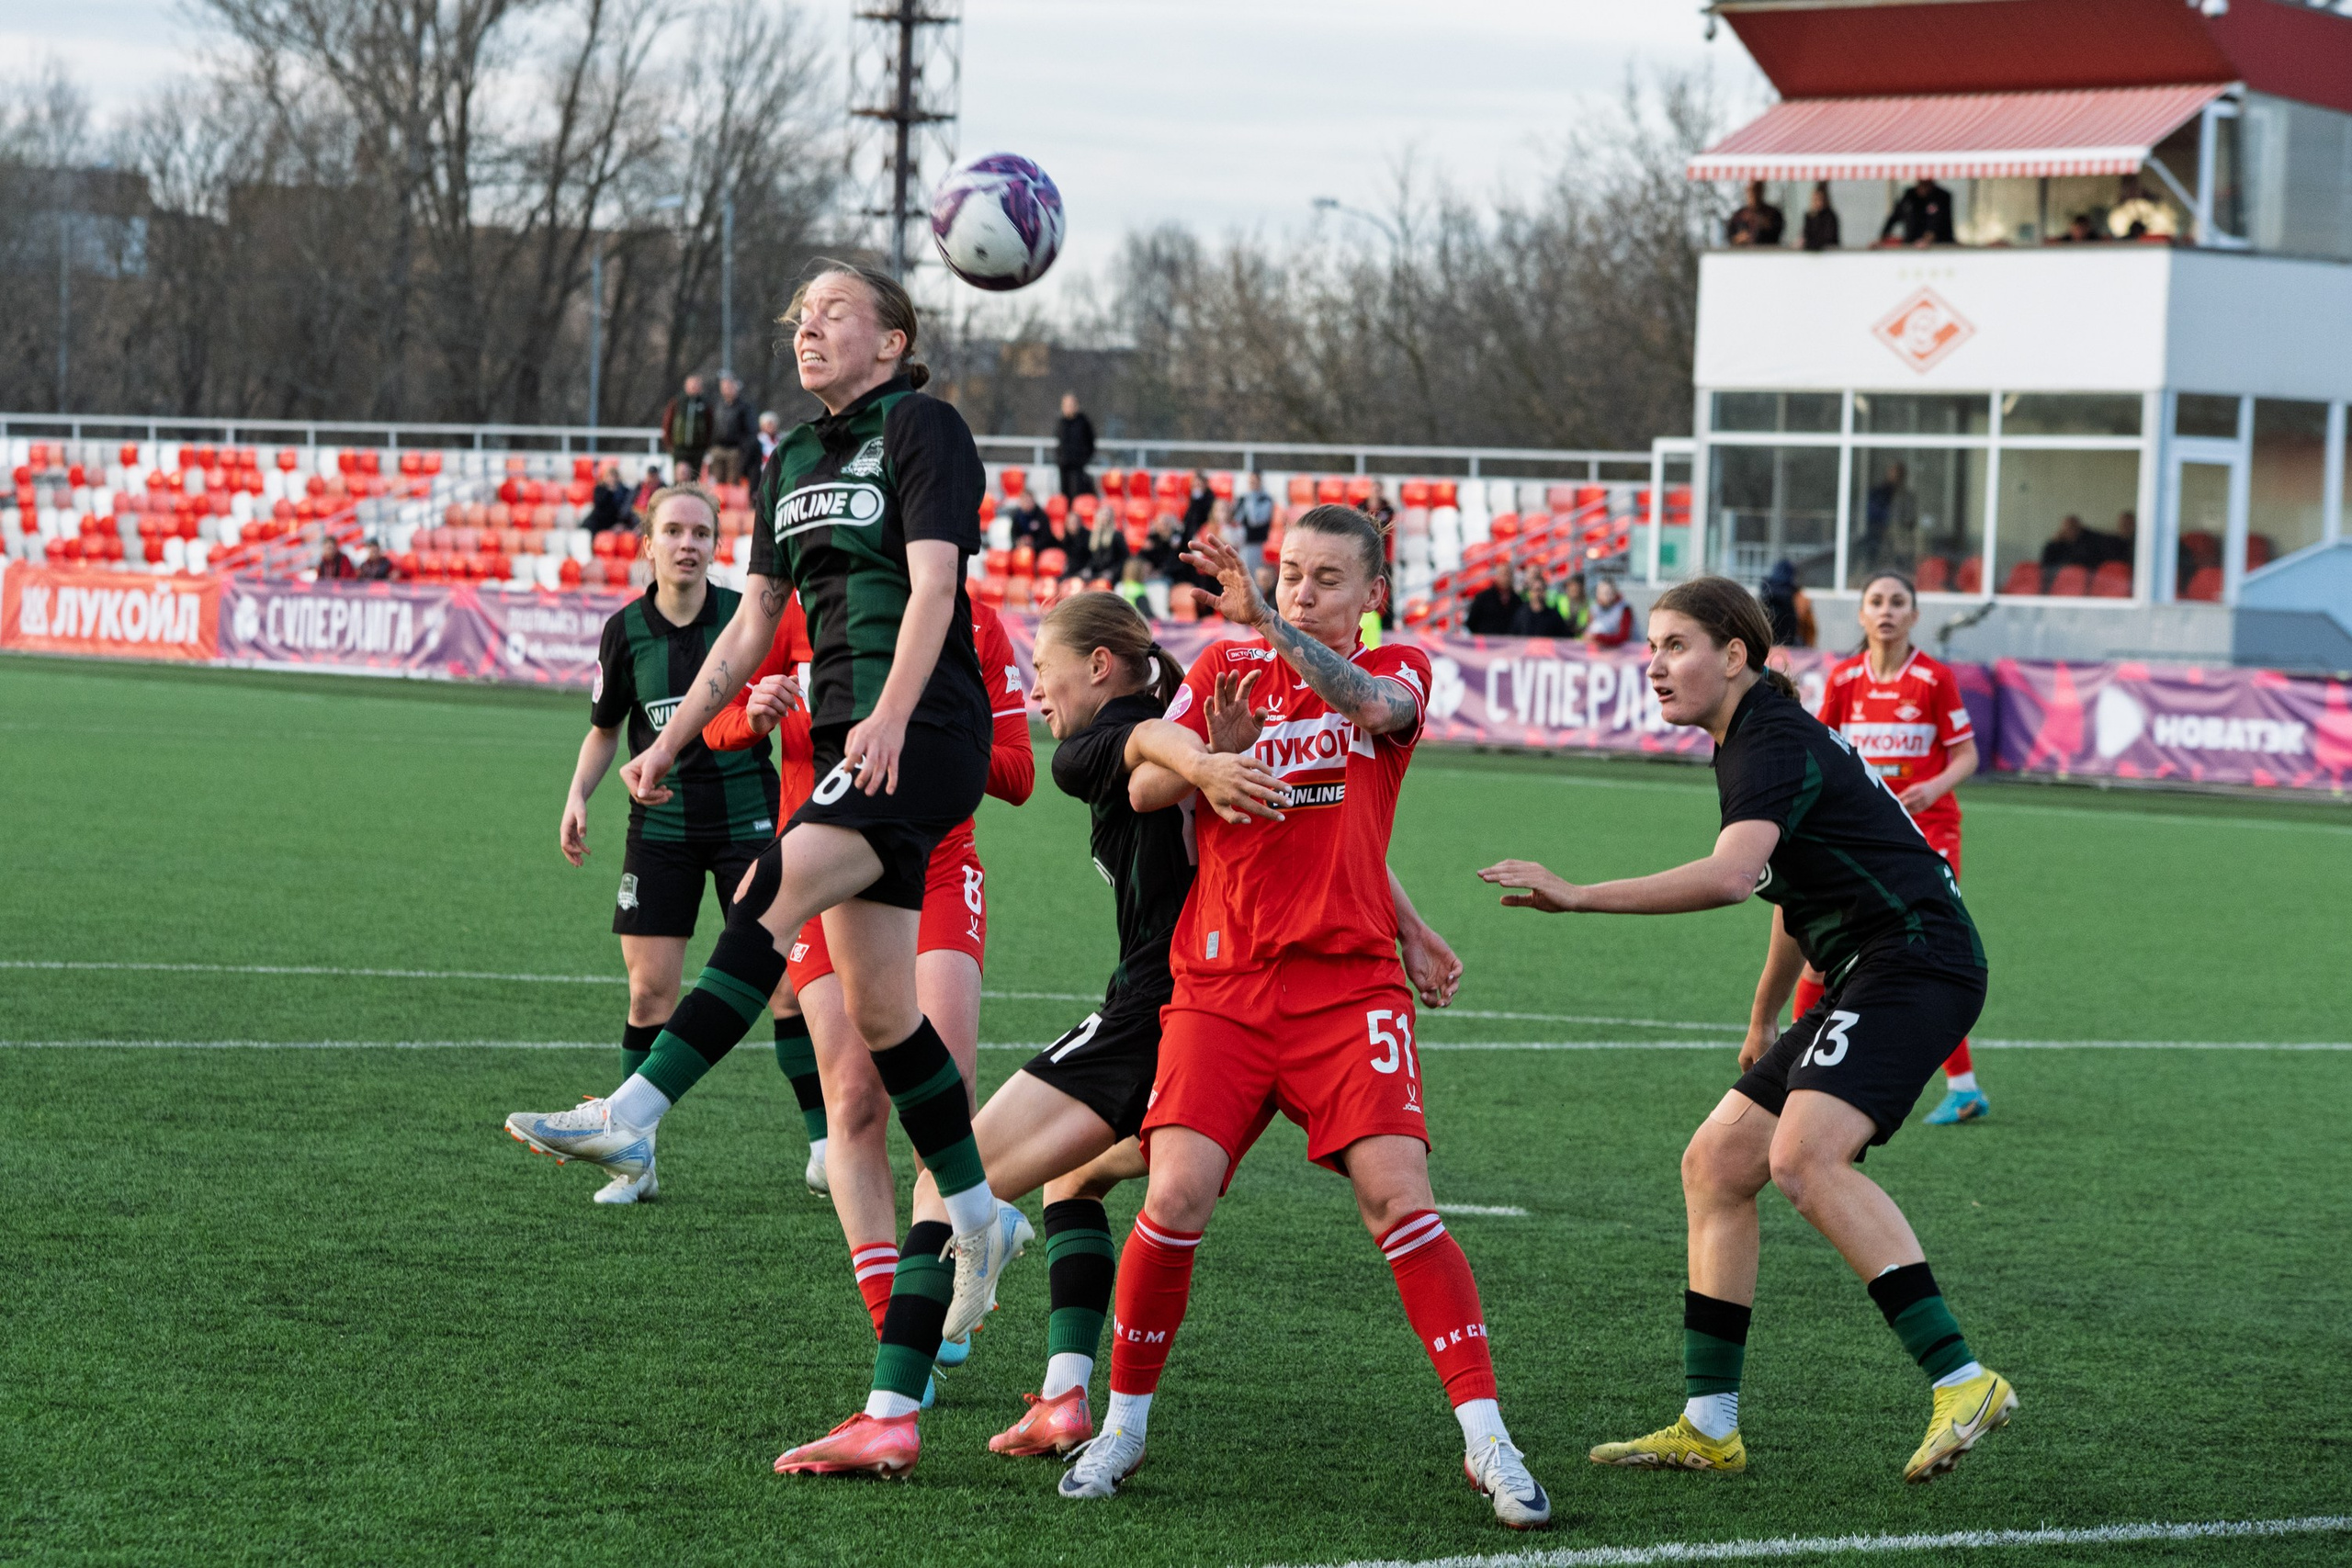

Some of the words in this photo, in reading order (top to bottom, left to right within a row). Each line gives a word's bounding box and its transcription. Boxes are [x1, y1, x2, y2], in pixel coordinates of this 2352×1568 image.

[51, 581, 200, 644] ЛУКОЙЛ
[266, 597, 413, 654] СУПЕРЛИГА
[1254, 721, 1361, 768] ЛУКОЙ
[2154, 714, 2307, 756] НОВАТЭК
[812, 754, 868, 806] 6
[962, 864, 983, 915] 8
[1366, 1010, 1415, 1078] 51
